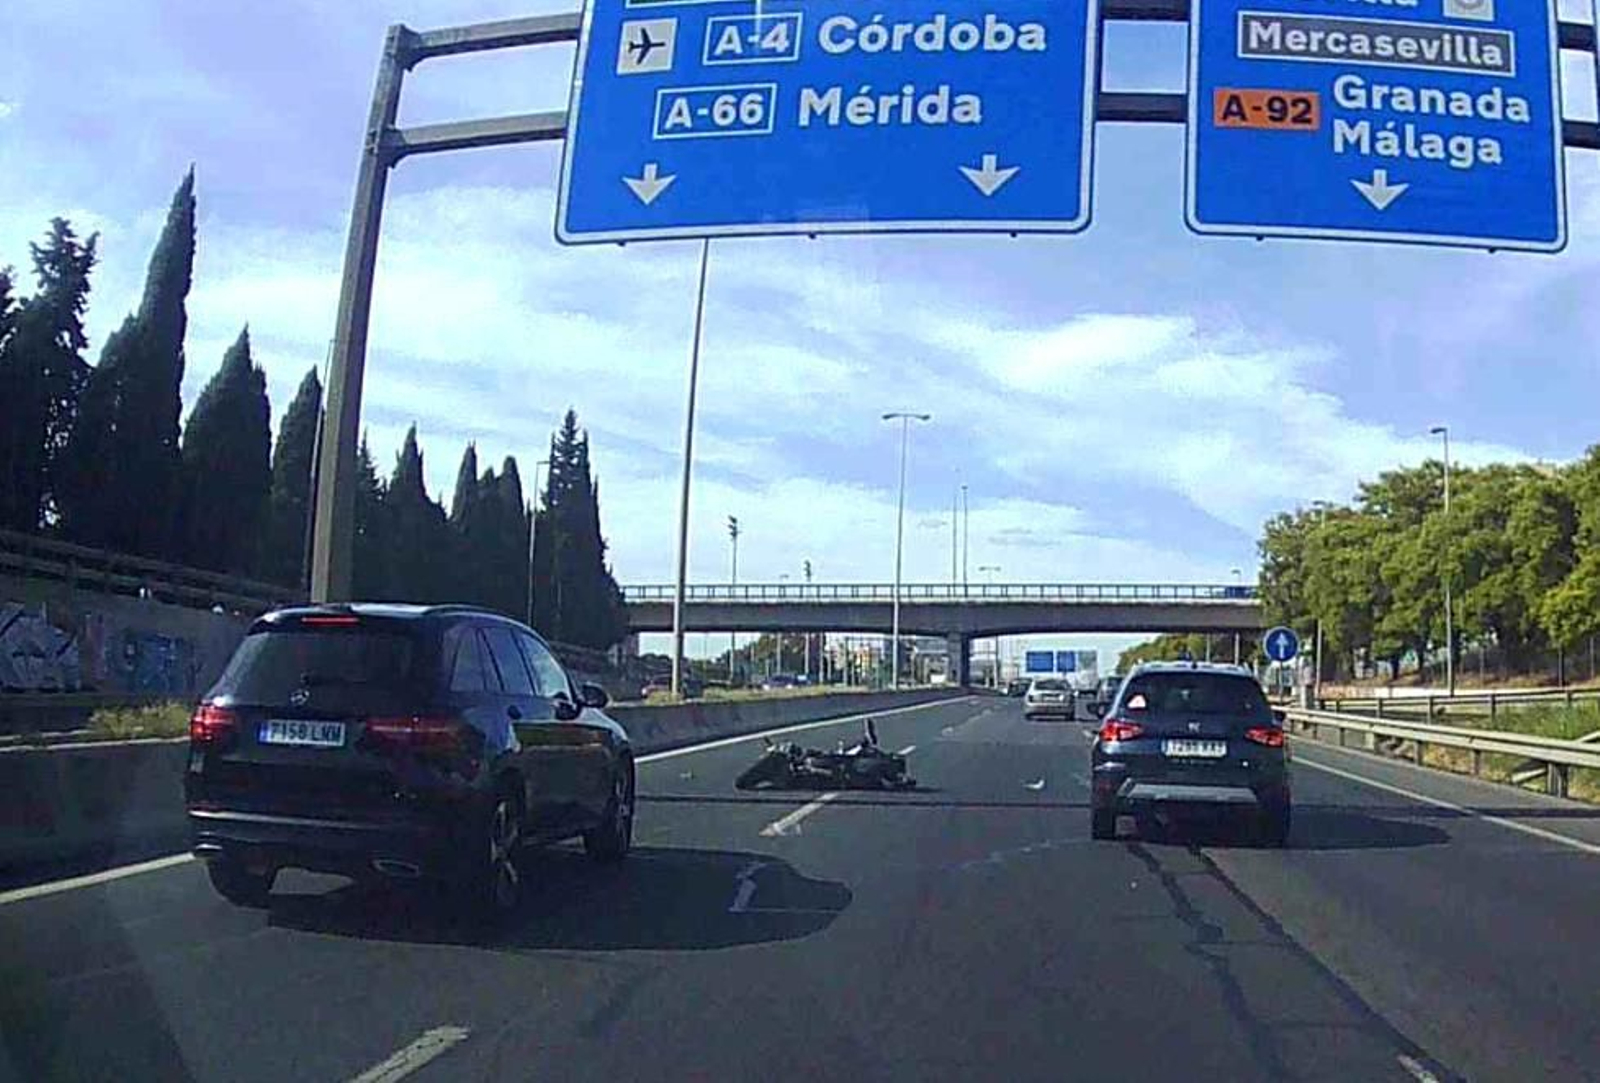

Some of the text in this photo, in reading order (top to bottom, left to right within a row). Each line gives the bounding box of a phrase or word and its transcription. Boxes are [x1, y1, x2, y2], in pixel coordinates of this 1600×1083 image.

[715, 15, 1047, 56] A-4 Córdoba
[1249, 20, 1503, 66] Mercasevilla
[664, 86, 982, 129] A-66 Mérida
[1221, 94, 1313, 124] A-92
[1333, 74, 1531, 123] Granada
[1333, 120, 1503, 168] Málaga
